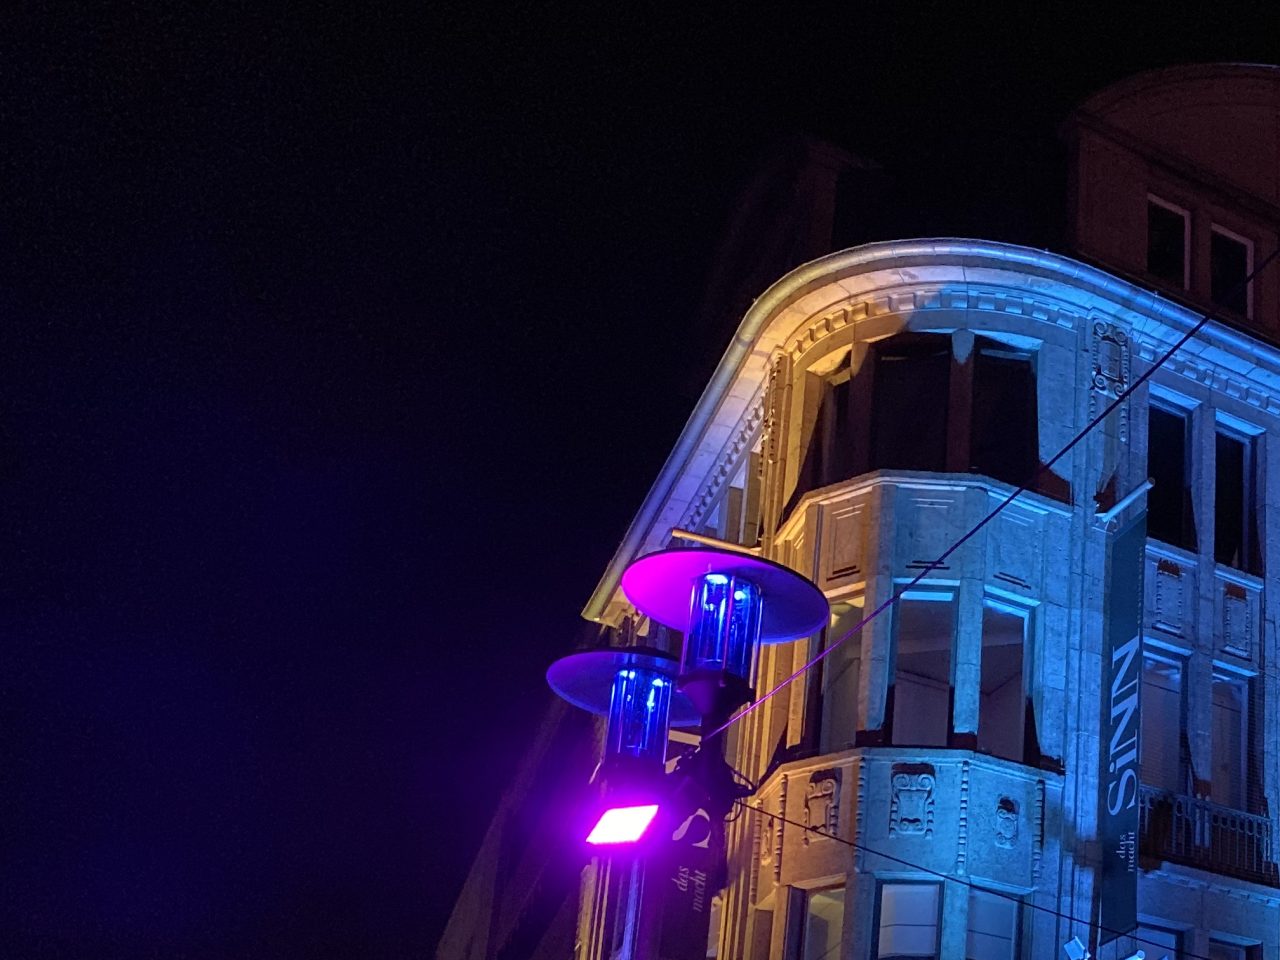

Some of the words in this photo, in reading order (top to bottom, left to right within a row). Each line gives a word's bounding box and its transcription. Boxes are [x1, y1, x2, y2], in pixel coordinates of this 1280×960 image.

[1107, 634, 1139, 816] SiNN
[1116, 834, 1126, 859] das
[1123, 832, 1135, 872] macht
[671, 865, 689, 892] das
[689, 869, 707, 912] macht
